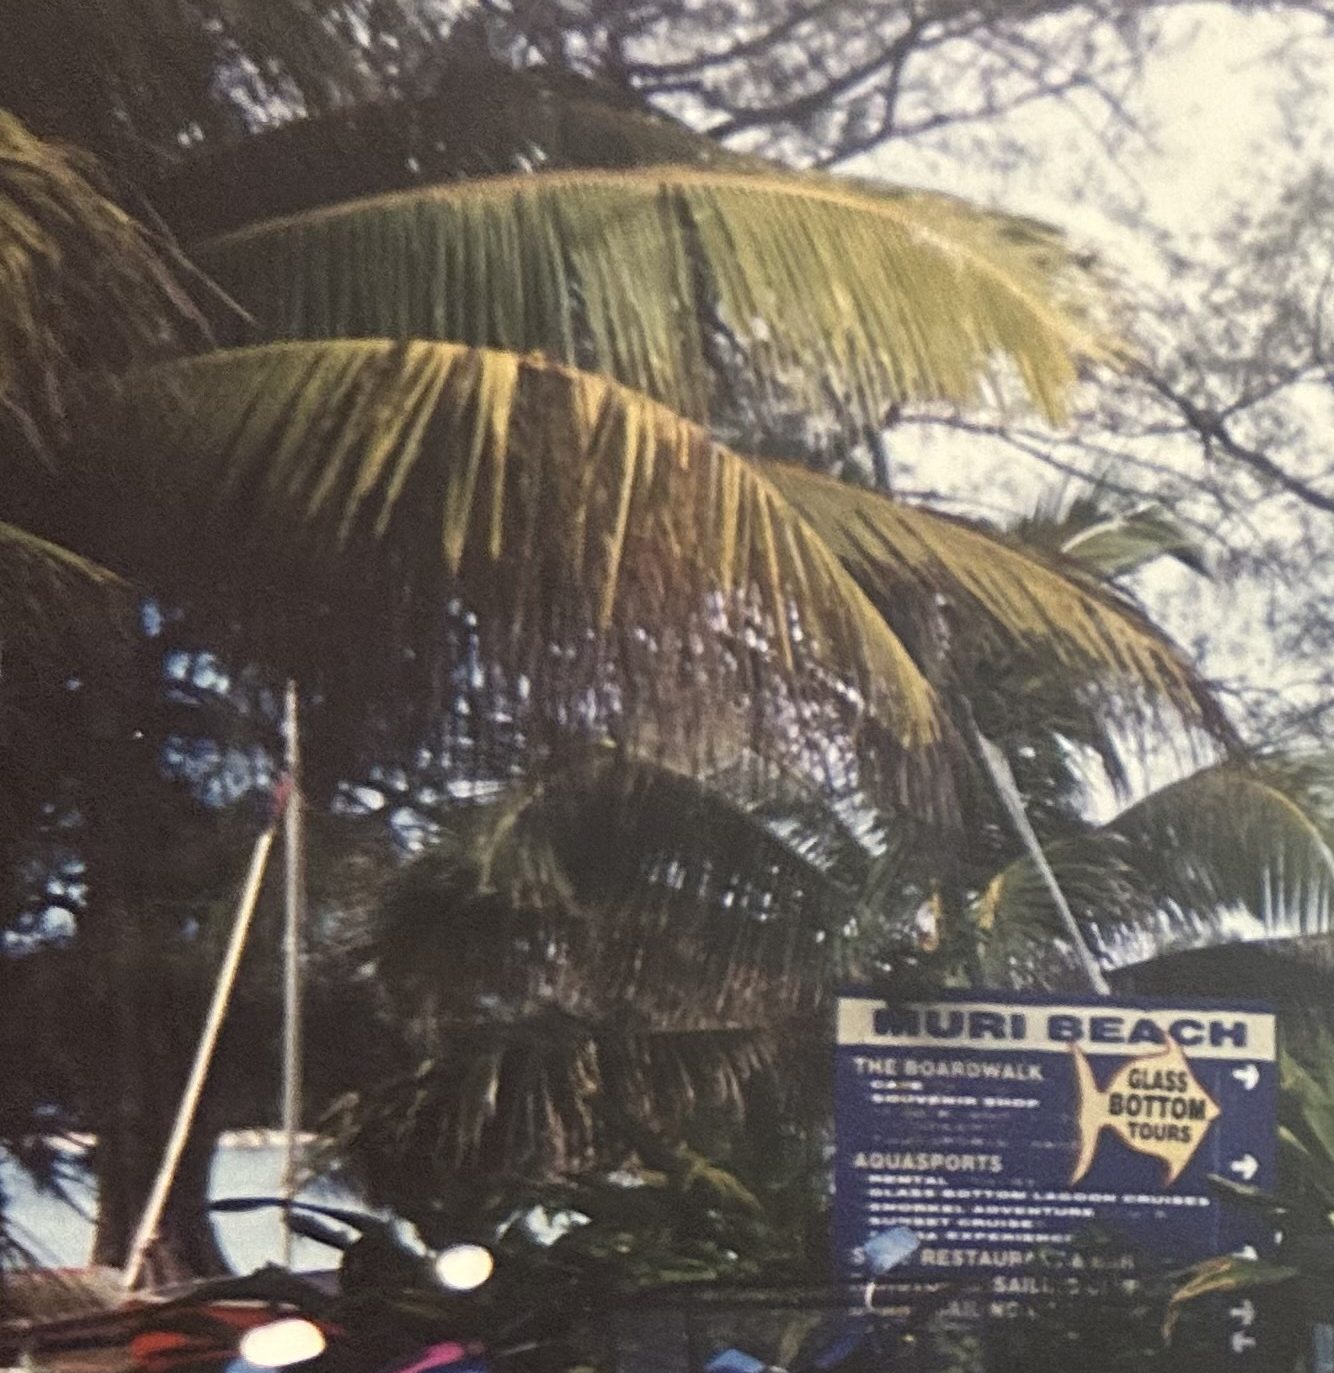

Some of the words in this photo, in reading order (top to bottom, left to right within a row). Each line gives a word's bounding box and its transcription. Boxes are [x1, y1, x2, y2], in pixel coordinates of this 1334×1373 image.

[873, 1007, 1026, 1040] MURI
[1047, 1014, 1248, 1048] BEACH
[853, 1057, 897, 1075] THE
[904, 1060, 1044, 1081] BOARDWALK
[1128, 1068, 1188, 1092] GLASS
[1109, 1093, 1206, 1120] BOTTOM
[1128, 1122, 1191, 1143] TOURS
[853, 1152, 1003, 1173] AQUASPORTS
[868, 1188, 935, 1199] GLASS
[941, 1188, 1026, 1200] BOTTOM
[919, 1248, 1066, 1267] RESTAUR
